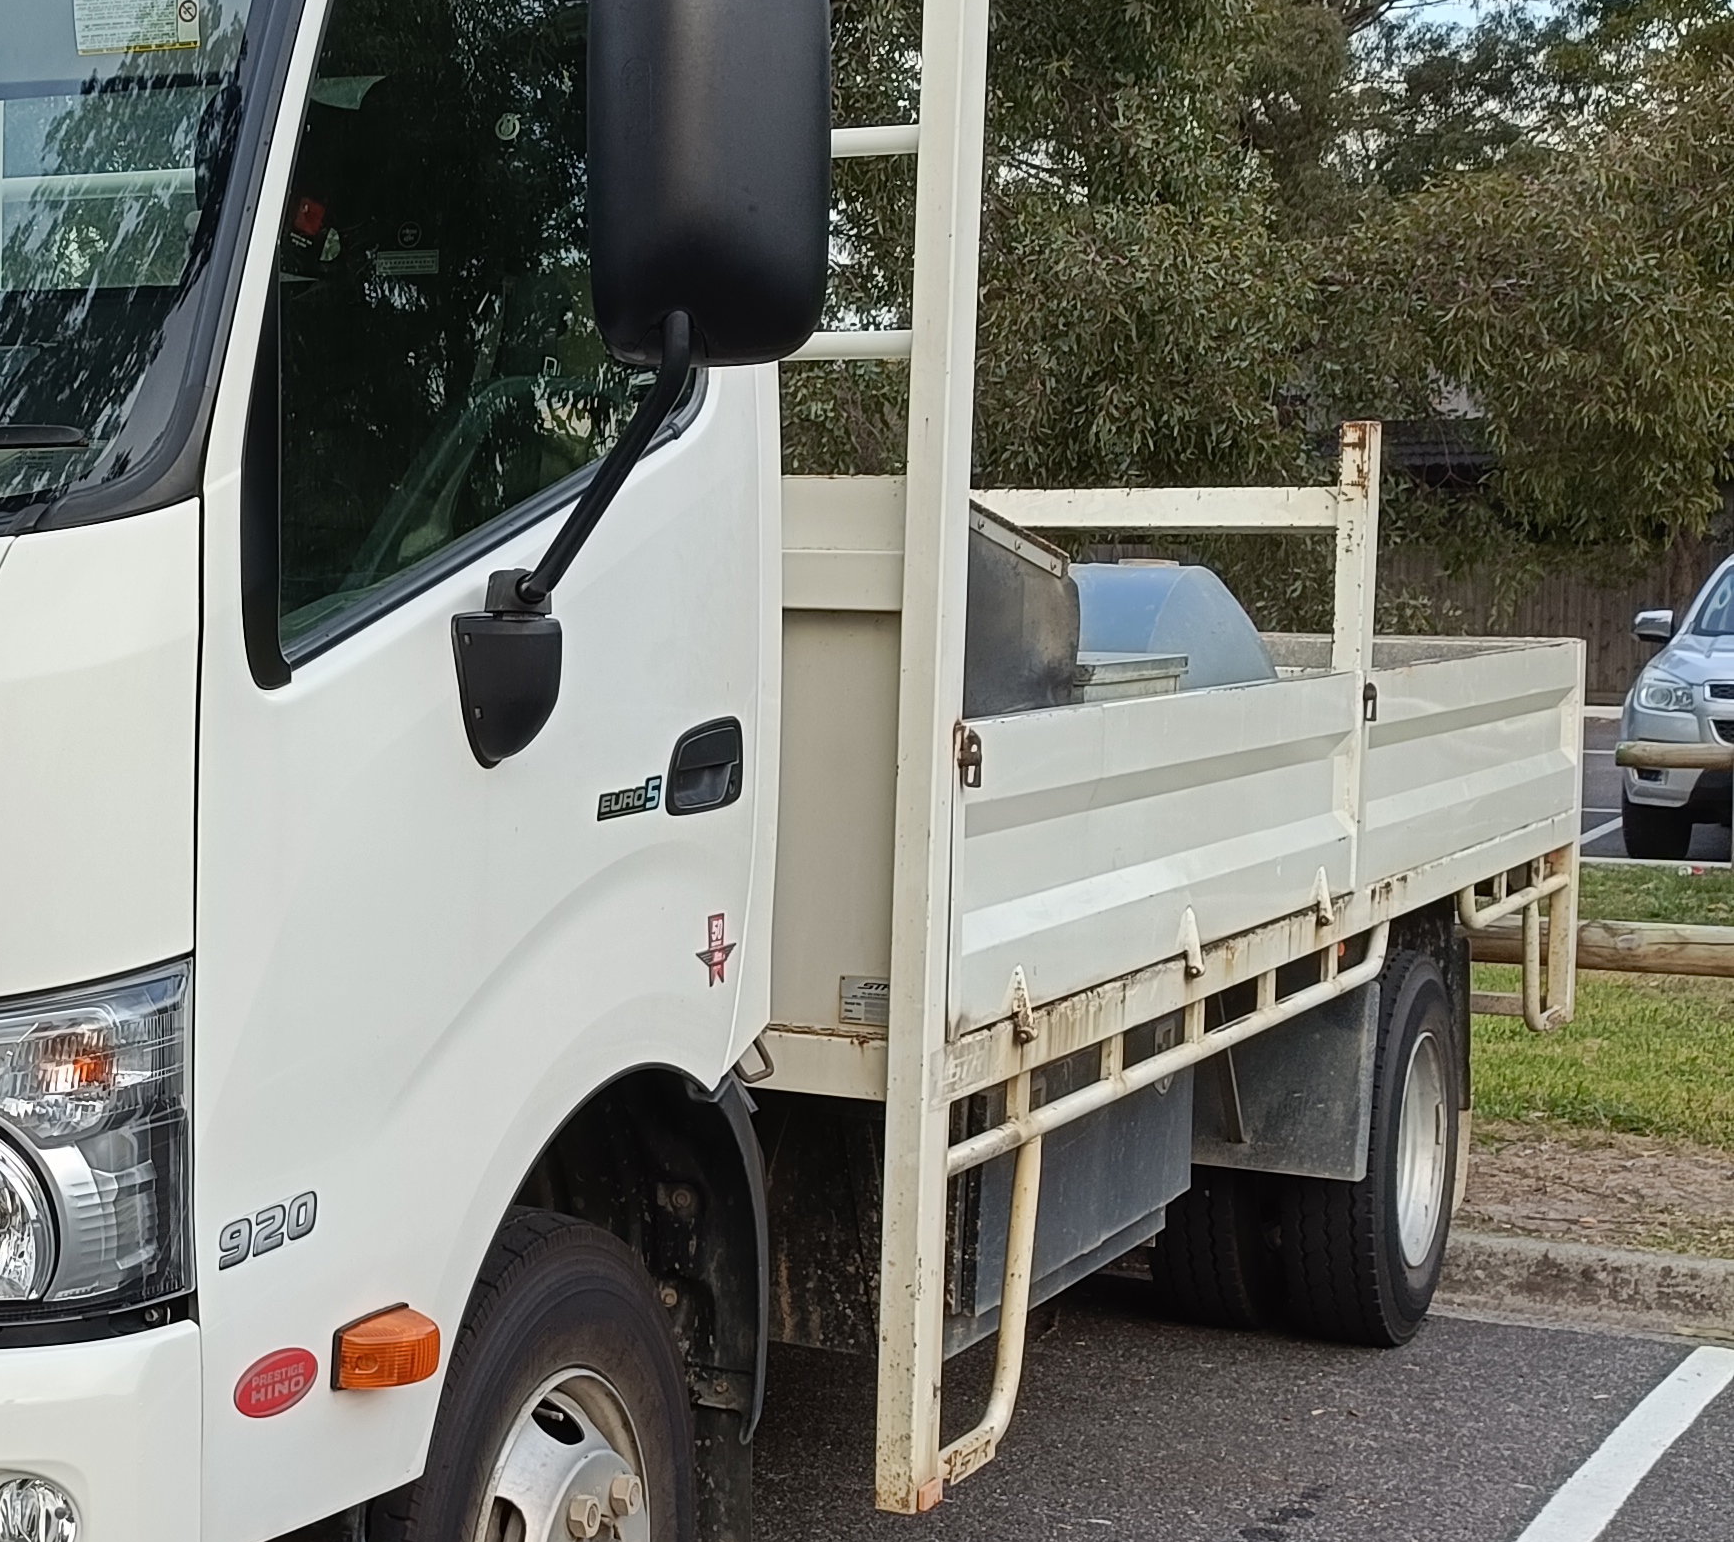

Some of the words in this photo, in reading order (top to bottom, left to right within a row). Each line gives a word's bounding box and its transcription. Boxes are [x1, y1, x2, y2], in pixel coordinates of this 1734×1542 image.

[711, 919, 723, 941] 50
[218, 1190, 317, 1271] 920
[251, 1361, 305, 1388] PRESTIGE
[250, 1375, 305, 1405] HINO
